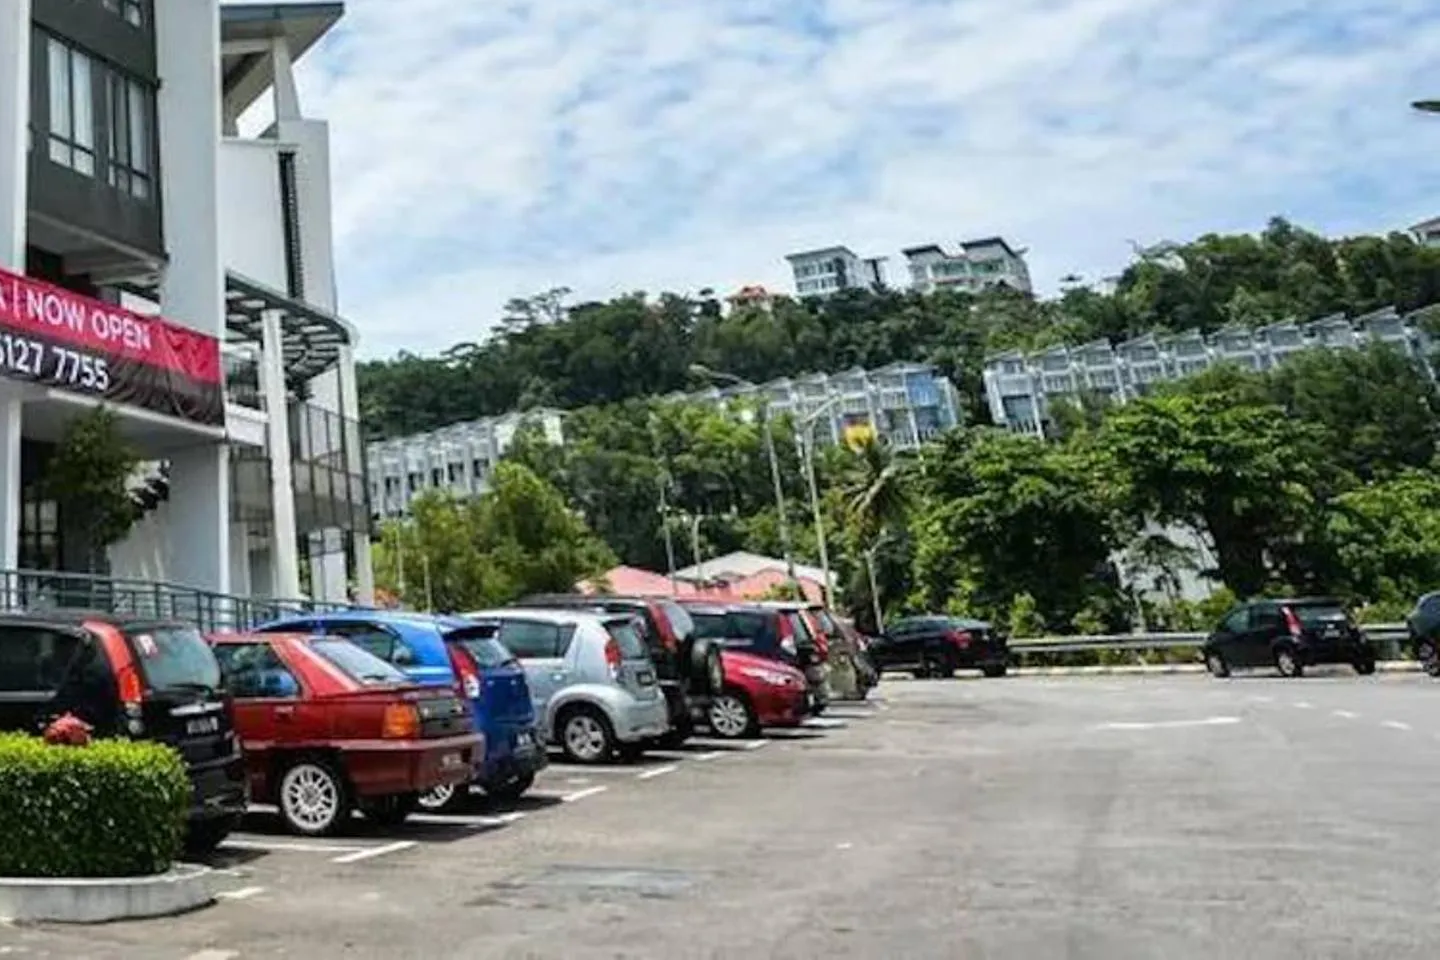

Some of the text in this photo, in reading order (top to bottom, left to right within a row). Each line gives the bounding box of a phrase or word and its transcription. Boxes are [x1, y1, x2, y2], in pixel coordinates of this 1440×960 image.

[26, 289, 86, 333] NOW
[91, 309, 152, 350] OPEN
[51, 345, 110, 390] 7755
